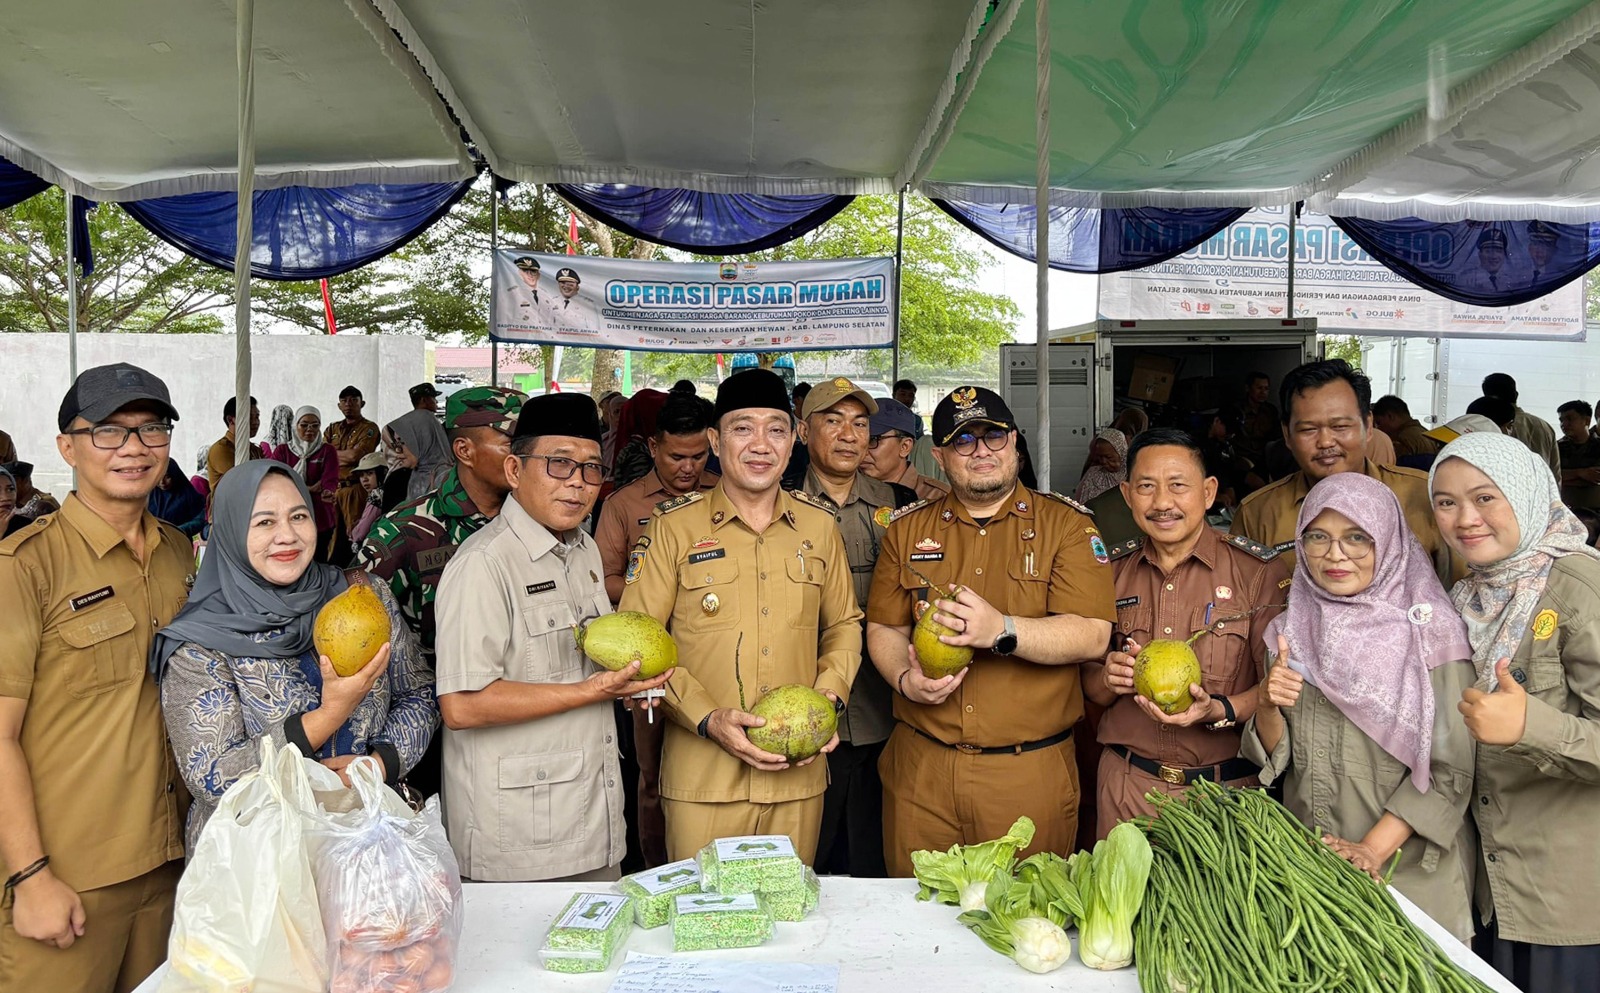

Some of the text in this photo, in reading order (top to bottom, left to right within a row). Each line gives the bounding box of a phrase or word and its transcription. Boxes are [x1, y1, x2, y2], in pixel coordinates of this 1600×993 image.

[607, 278, 882, 305] OPERASI PASAR MURAH
[699, 312, 725, 320] HARGA
[725, 312, 751, 320] BARANG
[753, 311, 792, 319] KEBUTUHAN
[793, 310, 816, 318] POKOK
[817, 309, 831, 317] DAN
[832, 307, 860, 316] PENTING
[861, 305, 889, 315] LAINNYA
[633, 325, 686, 333] PETERNAKAN
[852, 321, 885, 329] SELATAN
